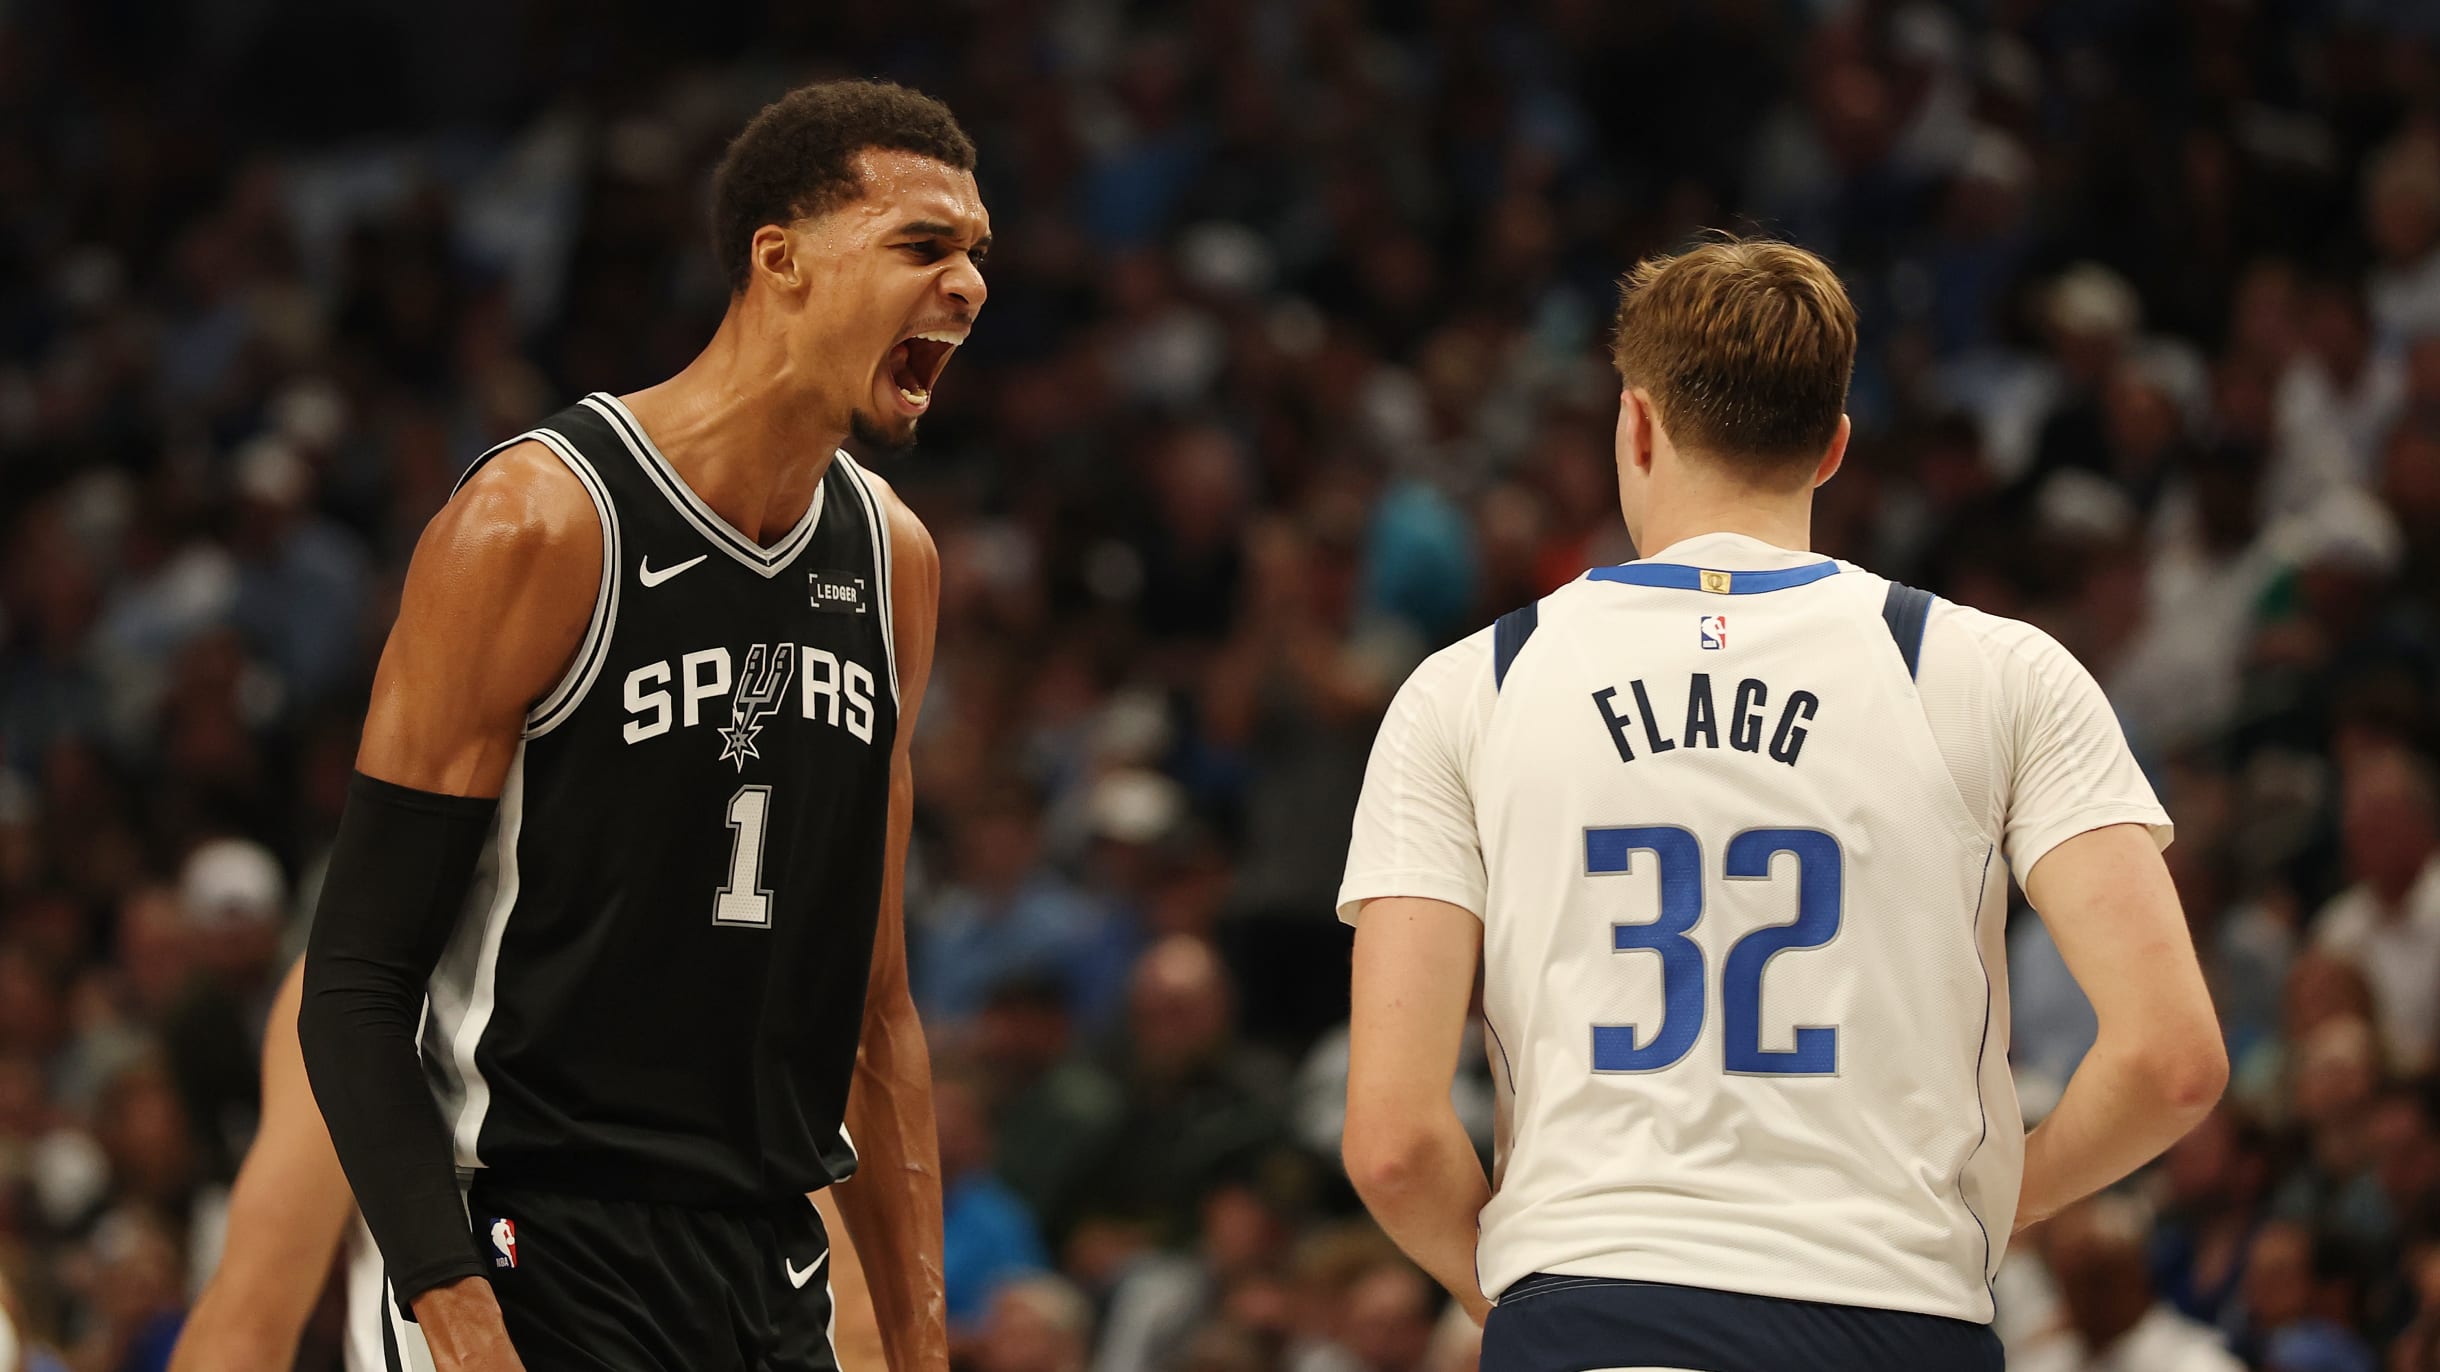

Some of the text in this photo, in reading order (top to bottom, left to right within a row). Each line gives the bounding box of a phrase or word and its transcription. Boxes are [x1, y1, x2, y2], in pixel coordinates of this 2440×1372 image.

[817, 583, 857, 603] LEDGER
[623, 642, 875, 774] SPURS
[1591, 672, 1820, 767] FLAGG
[712, 784, 774, 929] 1
[1582, 823, 1845, 1078] 32
